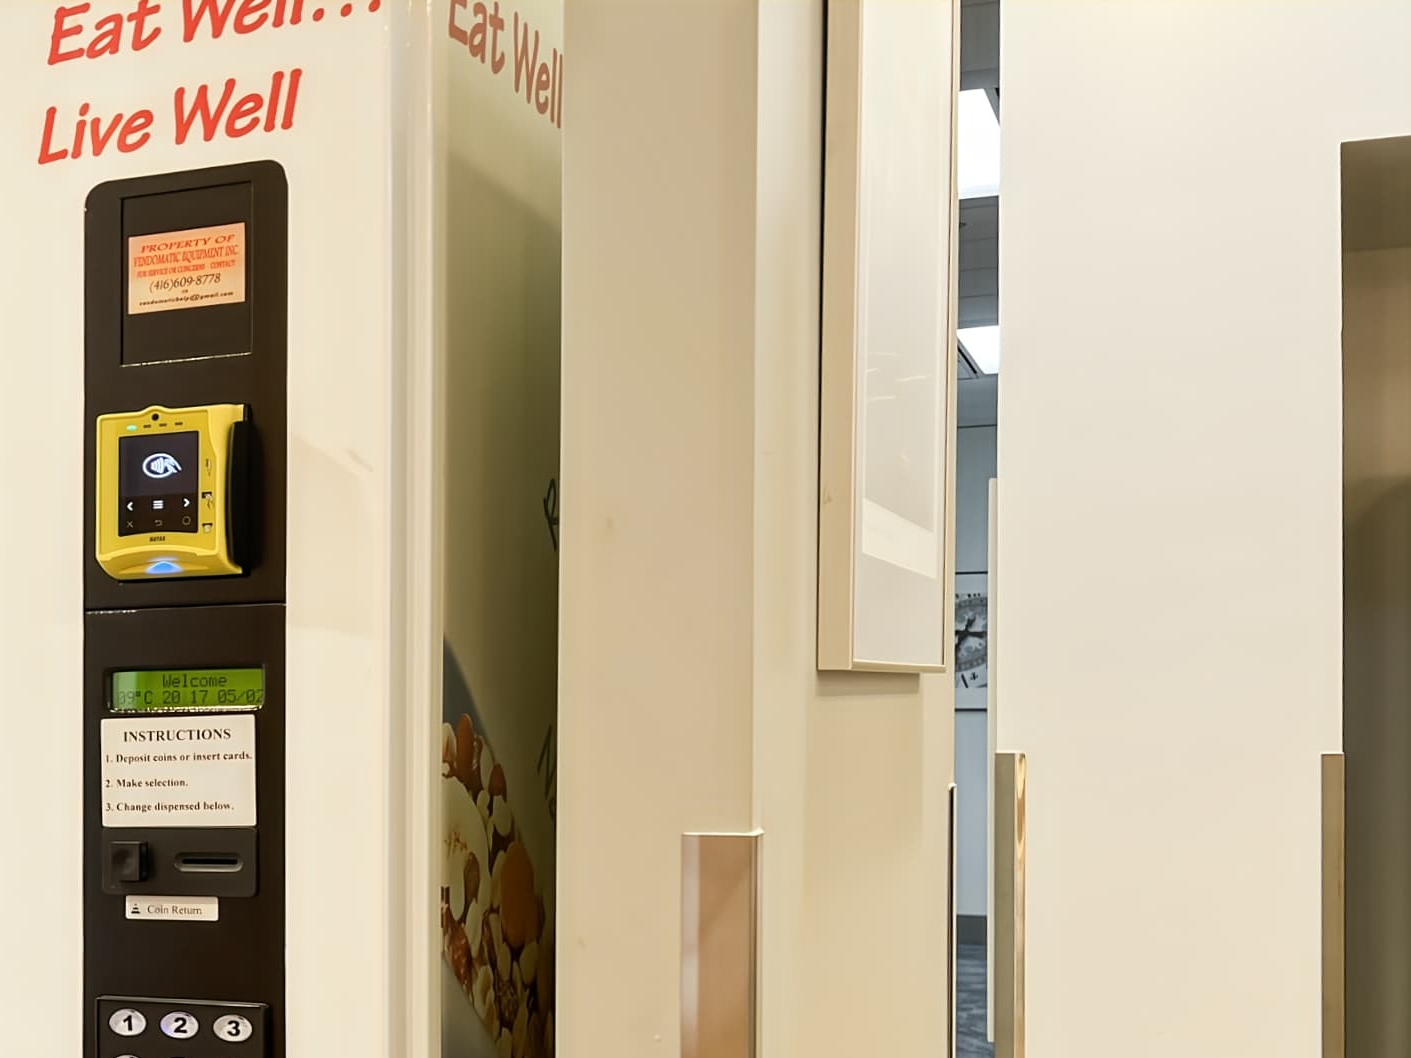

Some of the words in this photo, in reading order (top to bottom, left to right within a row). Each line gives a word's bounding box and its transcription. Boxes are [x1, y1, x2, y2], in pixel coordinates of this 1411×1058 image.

[47, 0, 162, 65] Eat
[447, 0, 505, 75] Eat
[38, 103, 154, 164] Live
[174, 69, 303, 145] Well
[141, 238, 211, 253] PROPERTY
[215, 234, 236, 244] OF
[149, 272, 221, 293] (416)609-8778
[163, 674, 228, 687] Welcome
[123, 728, 232, 742] INSTRUCTIONS
[116, 753, 151, 765] Deposit
[153, 753, 177, 762] coins
[179, 754, 189, 762] or
[193, 752, 220, 761] insert
[223, 751, 253, 760] cards.
[116, 778, 143, 788] Make
[145, 778, 189, 787] selection.
[116, 802, 152, 813] Change
[154, 802, 201, 812] dispensed
[203, 801, 235, 811] below.
[147, 904, 169, 915] Coin
[123, 1016, 133, 1031] 1
[174, 1017, 187, 1034] 2
[227, 1020, 241, 1036] 3
